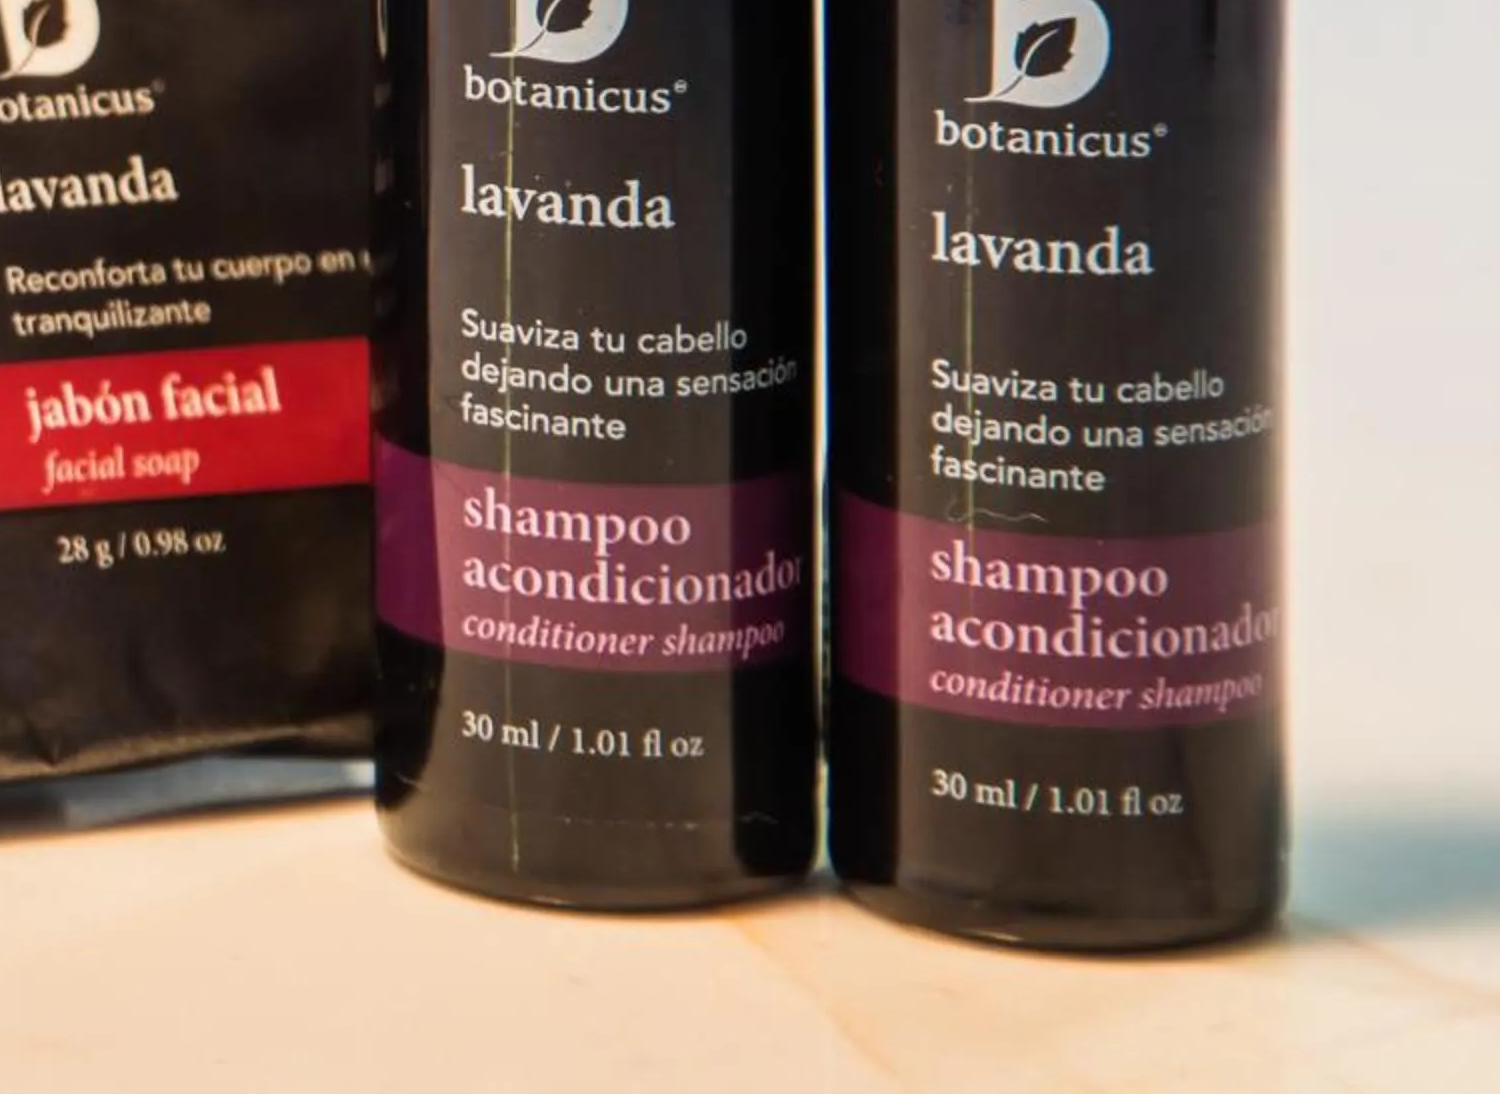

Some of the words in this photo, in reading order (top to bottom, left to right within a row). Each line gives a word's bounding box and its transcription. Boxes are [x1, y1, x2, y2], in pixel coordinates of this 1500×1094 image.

[460, 163, 676, 229] lavanda
[931, 211, 1154, 276] lavanda
[5, 258, 167, 295] Reconforta
[173, 258, 204, 282] tu
[212, 252, 312, 286] cuerpo
[319, 250, 355, 272] en
[12, 299, 212, 339] tranquilizante
[461, 308, 579, 352] Suaviza
[591, 326, 625, 353] tu
[637, 321, 747, 354] cabello
[461, 352, 592, 395] dejando
[605, 372, 665, 398] una
[676, 355, 797, 397] sensación
[931, 359, 1058, 402] Suaviza
[1068, 377, 1104, 403] tu
[1117, 370, 1224, 404] cabello
[24, 379, 151, 444] jabón
[161, 365, 282, 420] facial
[460, 393, 626, 440] fascinante
[931, 405, 1071, 447] dejando
[1083, 424, 1144, 448] una
[1154, 404, 1273, 447] sensación
[41, 444, 125, 496] facial
[133, 449, 200, 486] soap
[930, 445, 1106, 492] fascinante
[463, 487, 691, 557] shampoo
[57, 535, 89, 564] 28
[133, 529, 189, 556] 0.98
[195, 532, 226, 553] oz
[931, 540, 1168, 609] shampoo
[461, 613, 655, 656] conditioner
[662, 617, 785, 661] shampoo
[930, 669, 1131, 710] conditioner
[1140, 672, 1262, 713] shampoo
[461, 711, 494, 742] 30
[501, 720, 539, 751] ml
[571, 727, 631, 756] 1.01
[643, 730, 663, 757] fl
[671, 734, 704, 756] oz
[931, 769, 967, 800] 30
[975, 780, 1016, 809] ml
[1049, 786, 1109, 815] 1.01
[1121, 787, 1141, 816] fl
[1151, 792, 1183, 815] oz
